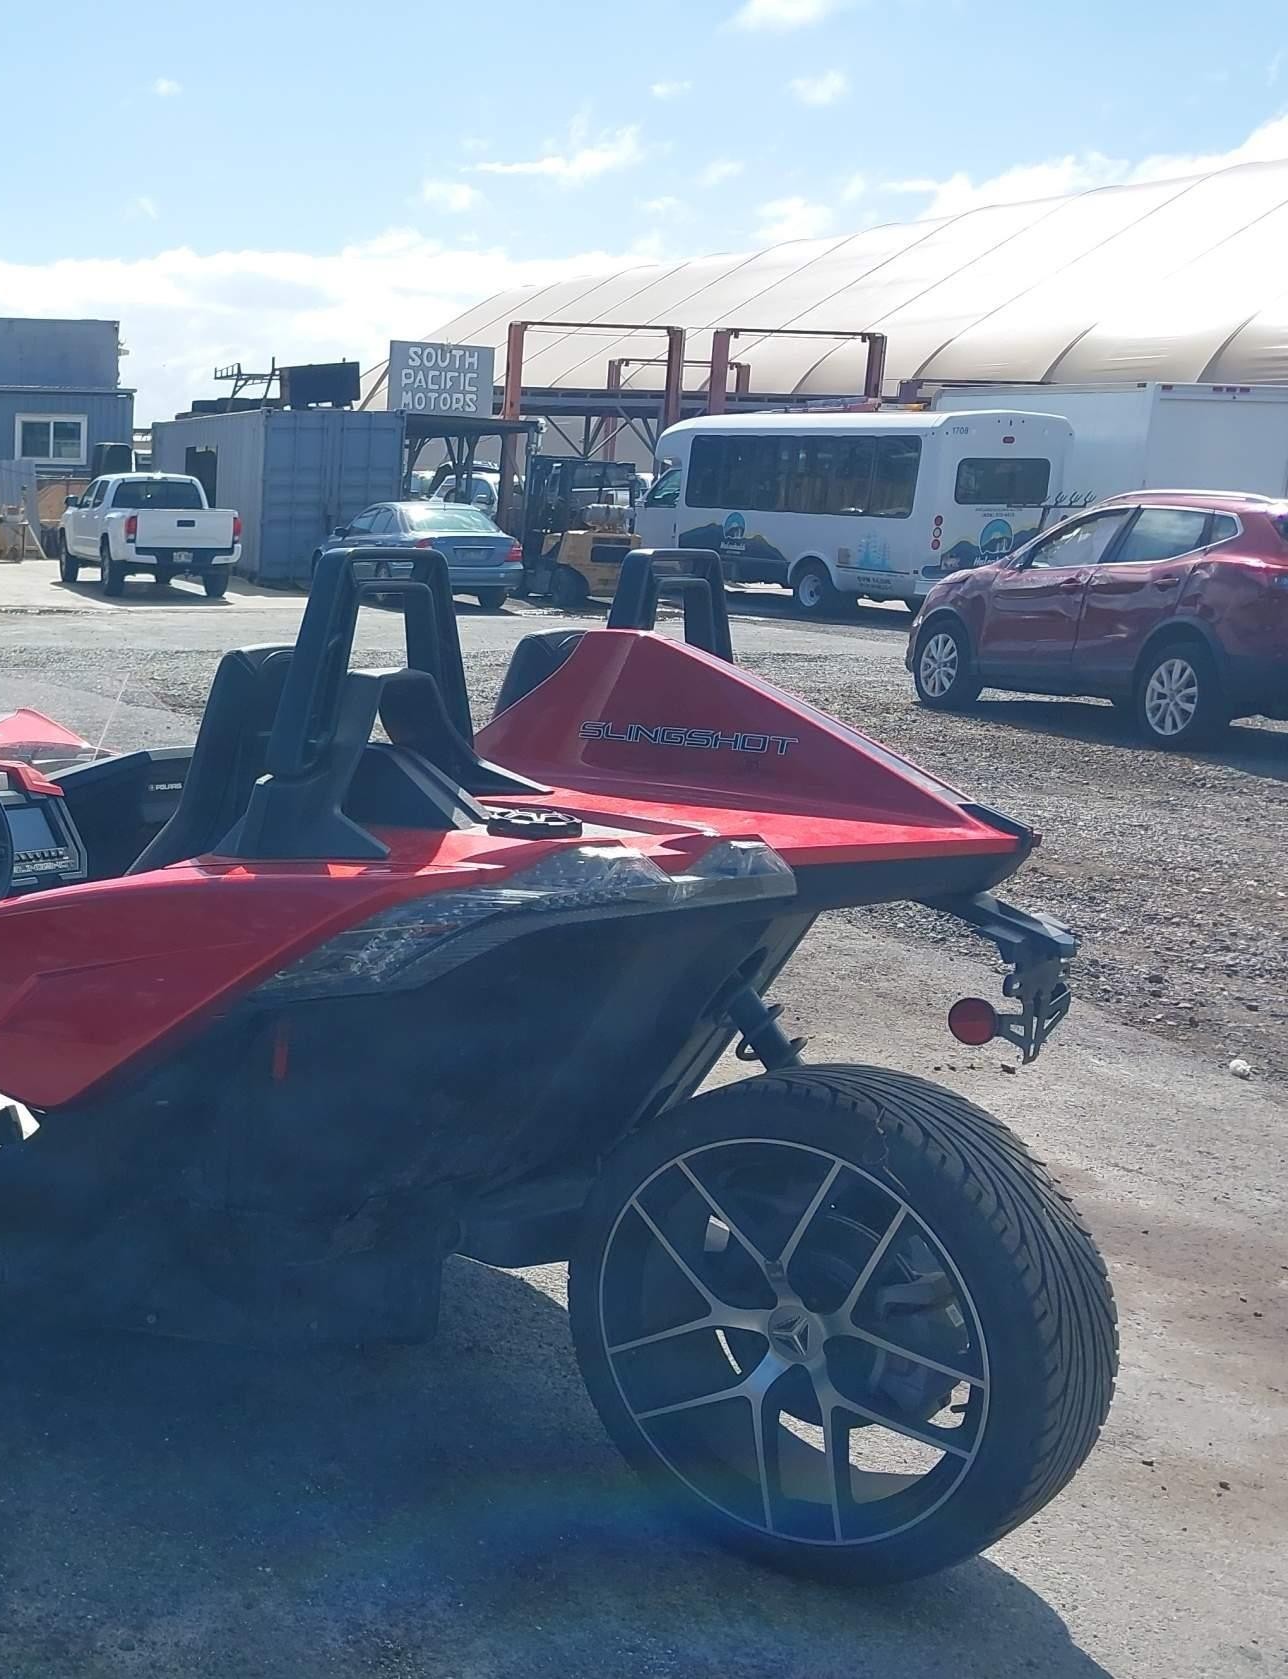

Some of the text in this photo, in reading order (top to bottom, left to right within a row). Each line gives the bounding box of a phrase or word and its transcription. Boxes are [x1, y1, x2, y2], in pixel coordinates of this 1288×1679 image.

[408, 347, 478, 369] SOUTH
[401, 368, 478, 391] PACIFIC
[401, 391, 476, 411] MOTORS
[578, 720, 799, 756] SLINGSHOT
